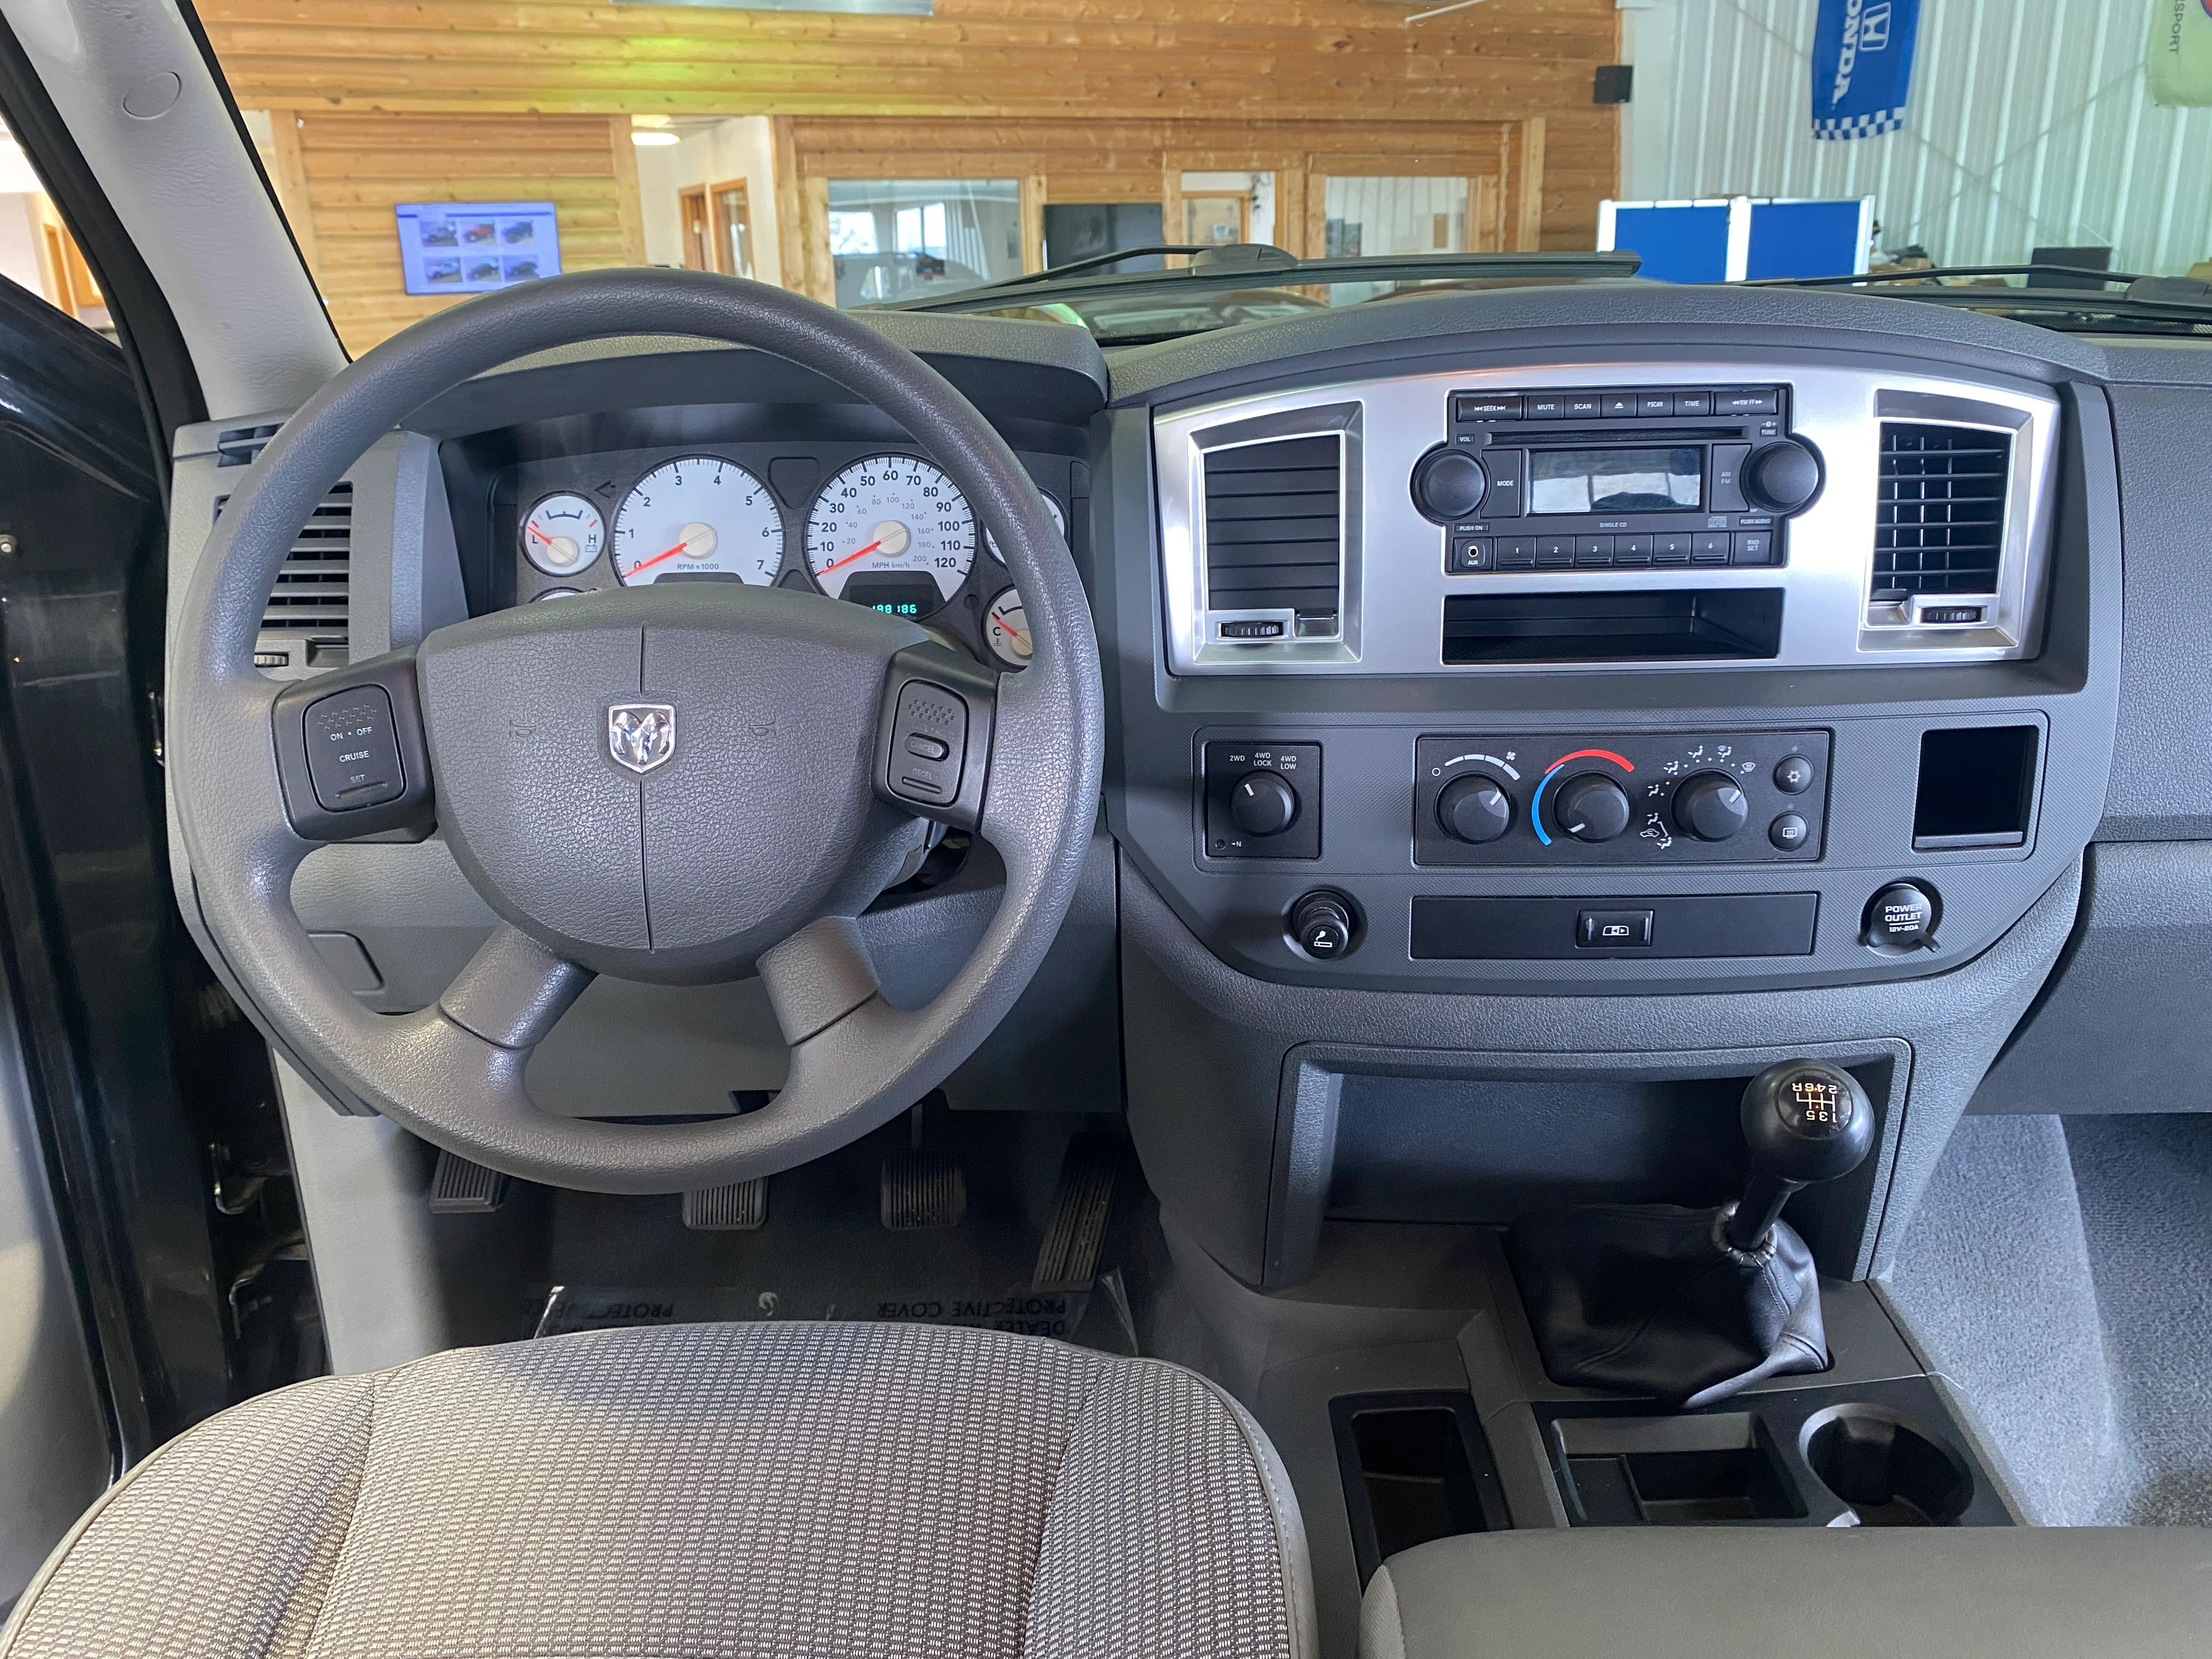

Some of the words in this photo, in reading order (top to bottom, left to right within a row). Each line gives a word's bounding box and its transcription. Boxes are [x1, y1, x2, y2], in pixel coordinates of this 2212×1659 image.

[2169, 0, 2186, 54] SPORT
[713, 475, 721, 485] 4
[883, 470, 898, 481] 60
[906, 475, 921, 486] 70
[675, 476, 682, 486] 3
[860, 476, 876, 486] 50
[841, 488, 857, 498] 40
[923, 487, 938, 497] 80
[644, 497, 651, 507] 2
[745, 496, 753, 506] 5
[830, 503, 845, 513] 30
[936, 501, 952, 512] 90
[821, 522, 837, 532] 20
[938, 521, 960, 531] 100
[629, 528, 634, 538] 1
[762, 527, 769, 537] 6
[532, 535, 538, 544] L
[588, 534, 596, 544] H
[820, 541, 834, 551] 10
[940, 540, 960, 550] 110
[634, 560, 642, 570] 0
[757, 560, 764, 570] 7
[826, 558, 834, 568] 0
[934, 557, 956, 568] 120
[992, 627, 1001, 636] C
[330, 732, 343, 741] ON
[357, 726, 373, 736] OFF
[910, 741, 935, 754] CANCEL
[339, 751, 370, 763] CRUISE
[351, 774, 365, 783] SET
[913, 768, 932, 780] DECEL
[1885, 904, 1922, 913] POWER
[1884, 912, 1922, 922] OUTLET
[1889, 924, 1919, 933] 12V-20A
[877, 1301, 942, 1318] COVER
